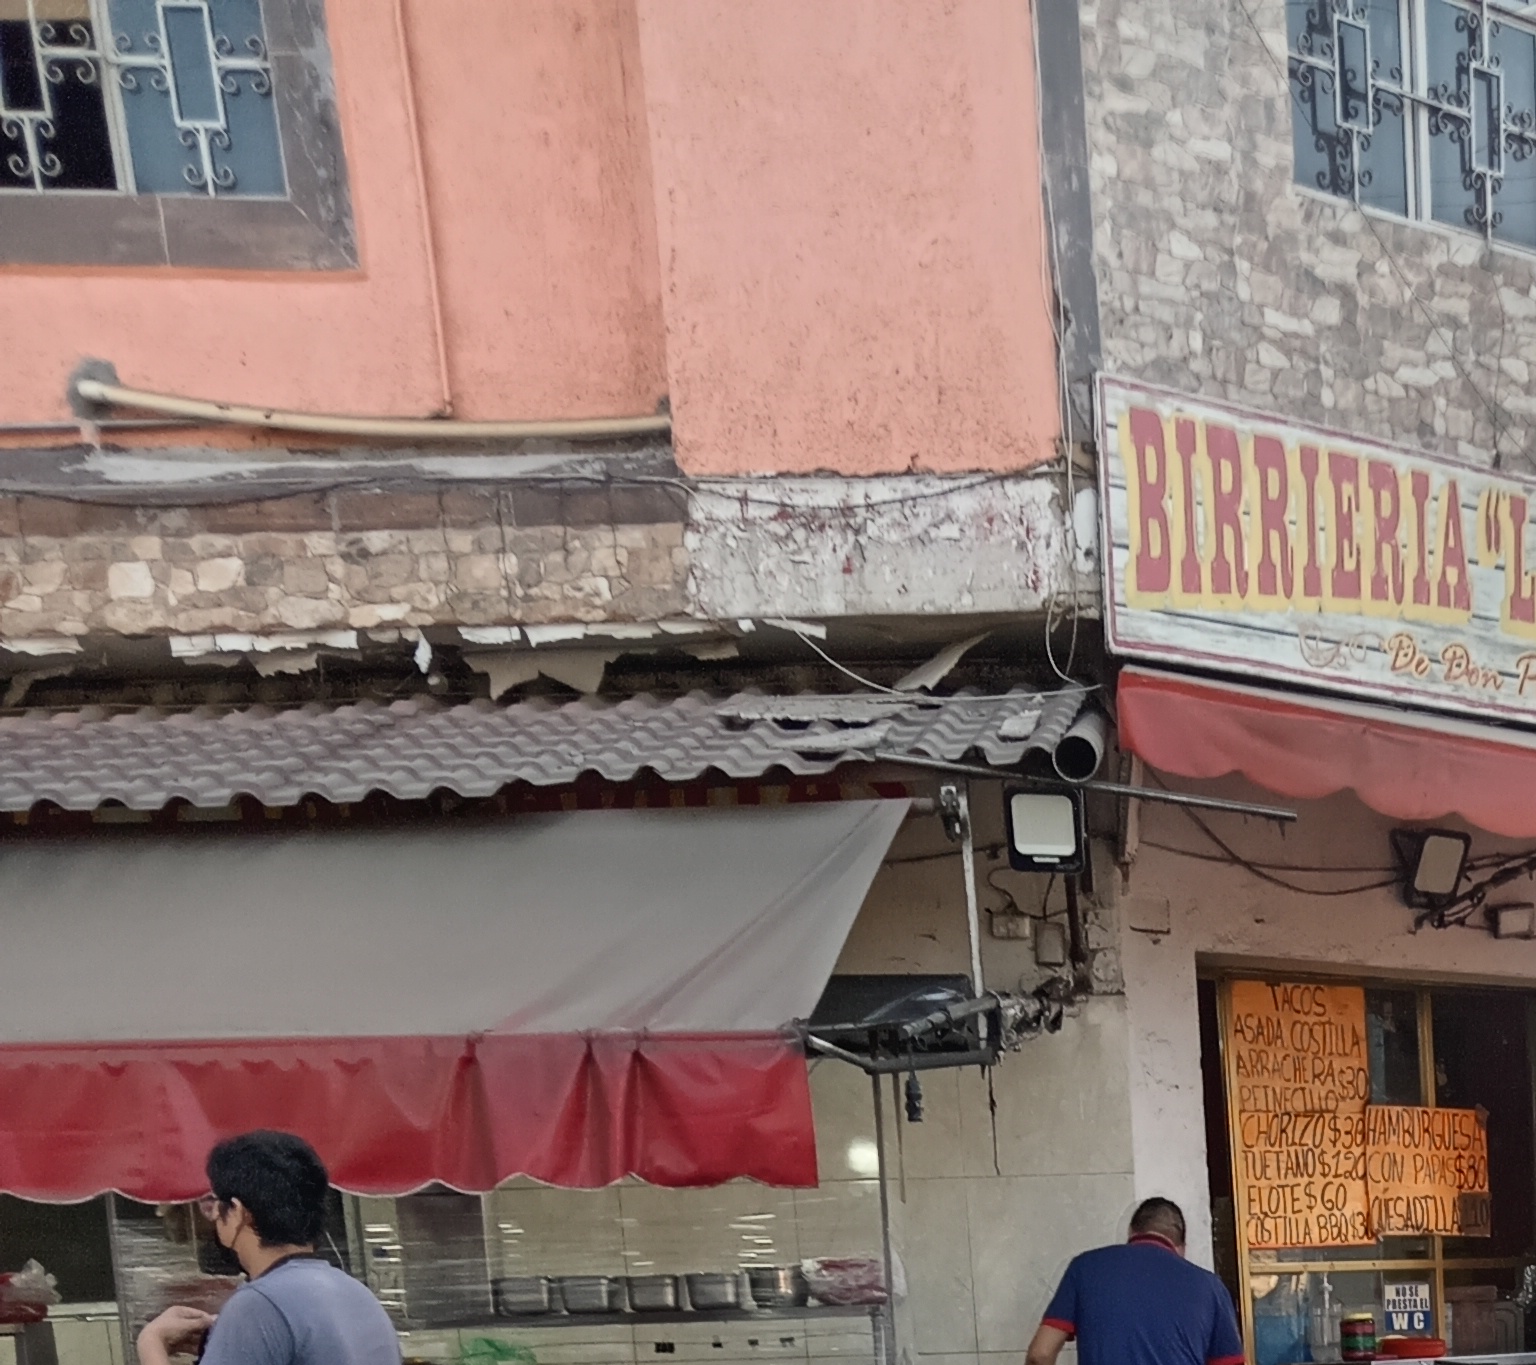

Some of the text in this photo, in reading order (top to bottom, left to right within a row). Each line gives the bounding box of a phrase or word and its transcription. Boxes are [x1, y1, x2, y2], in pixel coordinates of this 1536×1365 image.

[1126, 407, 1472, 615] BIRRIERIA
[1388, 633, 1430, 677] De
[1442, 643, 1504, 691] Don
[1265, 981, 1327, 1017] TACOS
[1290, 1018, 1362, 1058] COSTILLA
[1236, 1050, 1369, 1101] ARRACHERA $30
[1242, 1113, 1325, 1149] CHORIZO
[1366, 1108, 1485, 1152] HAMBURGUESA
[1242, 1148, 1367, 1182] TUETANO $120
[1368, 1151, 1487, 1190] CON PAPAS $80
[1247, 1181, 1347, 1216] ELOTE $60
[1246, 1213, 1313, 1247] COSTILLA
[1316, 1212, 1349, 1244] BBQ
[1386, 1297, 1429, 1310] PRESTA EL
[1395, 1285, 1419, 1298] NO SE
